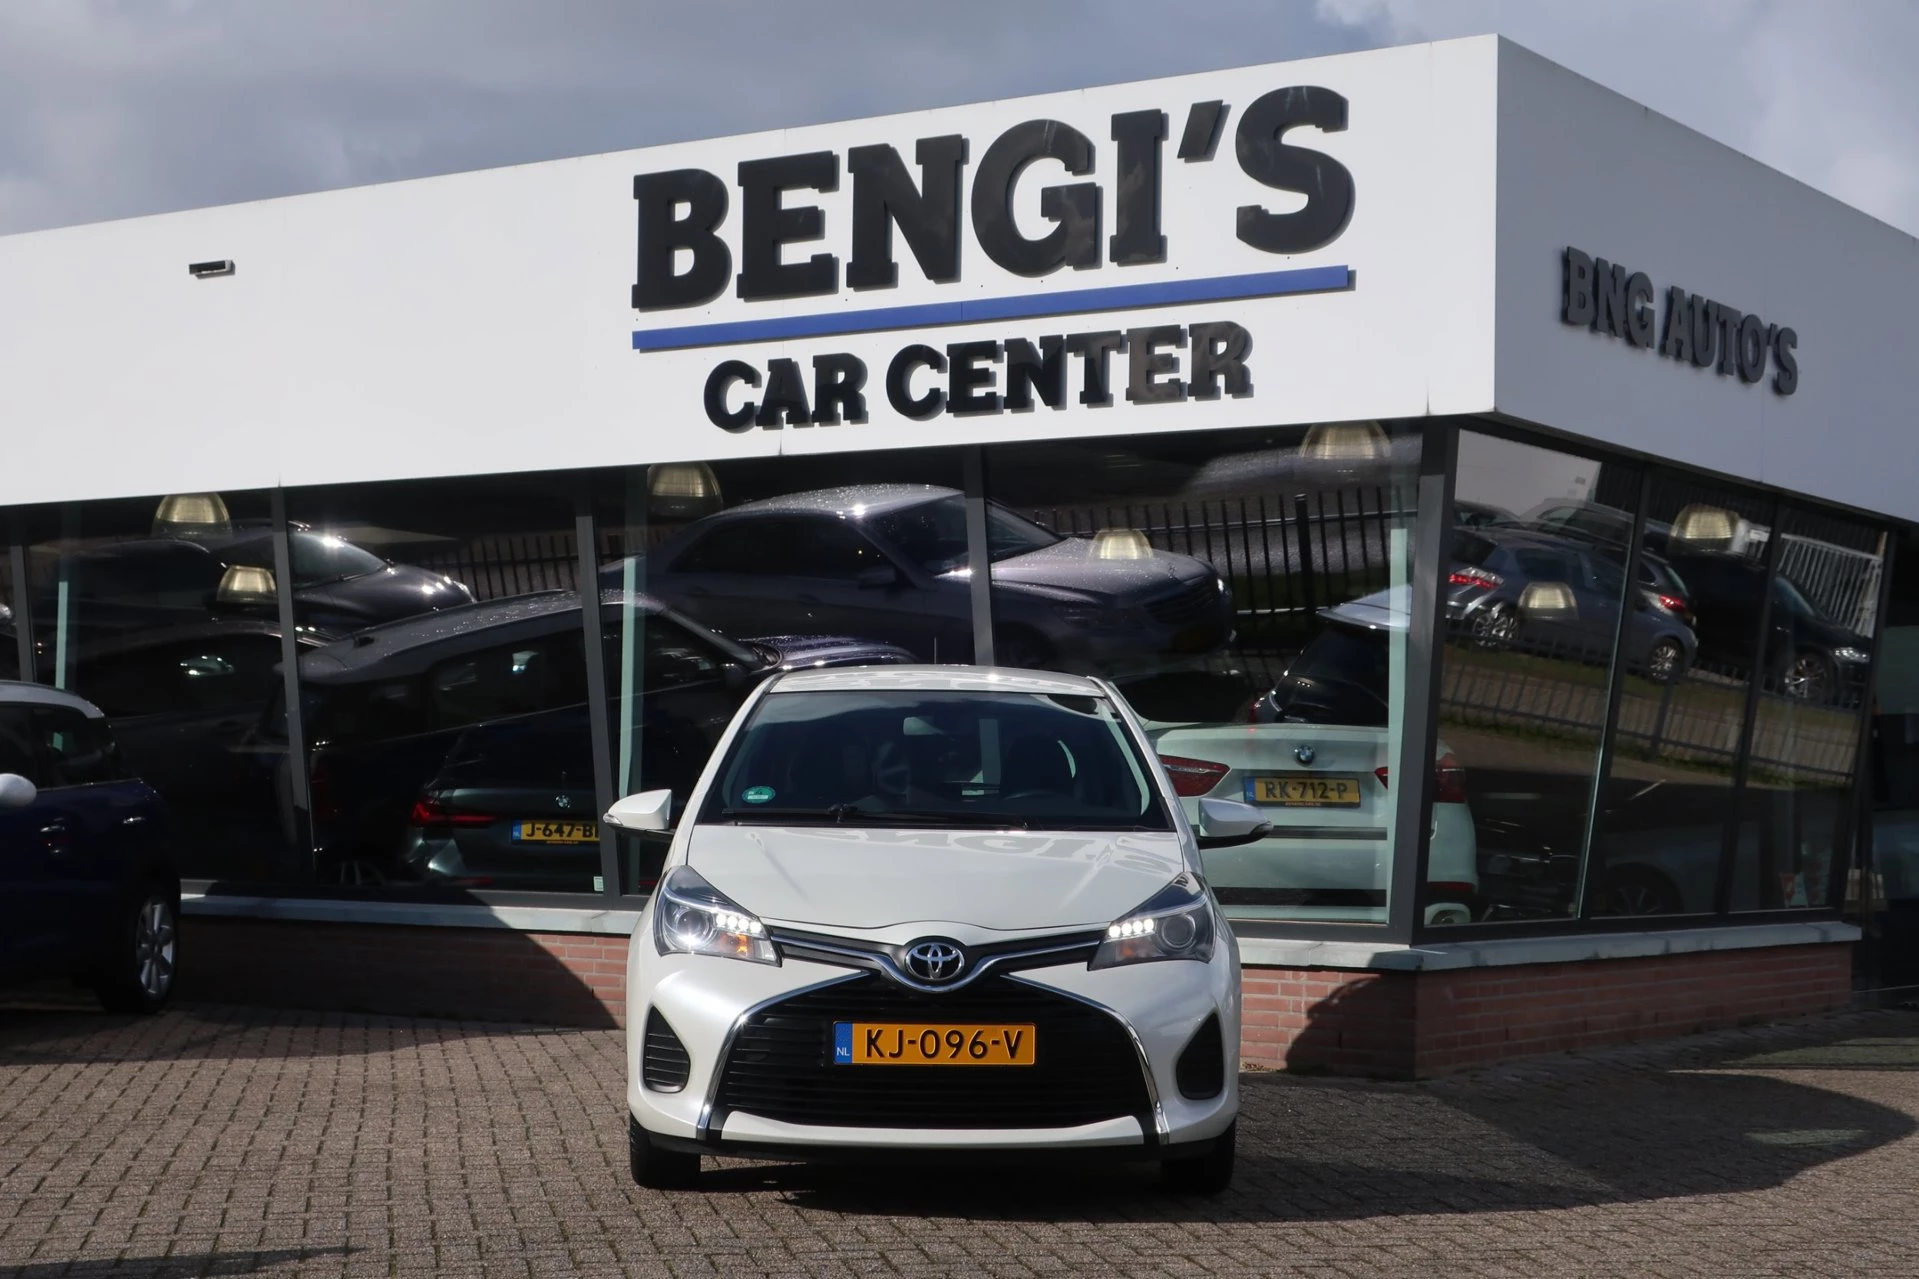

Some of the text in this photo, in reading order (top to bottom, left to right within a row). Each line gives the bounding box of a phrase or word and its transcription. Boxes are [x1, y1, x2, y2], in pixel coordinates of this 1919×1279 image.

[632, 85, 1355, 312] BENGI'S
[1562, 246, 1798, 396] BNG AUTO'S
[703, 321, 1254, 431] CAR CENTER
[1264, 781, 1348, 800] RK-712-P
[836, 1046, 850, 1056] NL
[865, 1028, 1024, 1060] KJ-096-V
